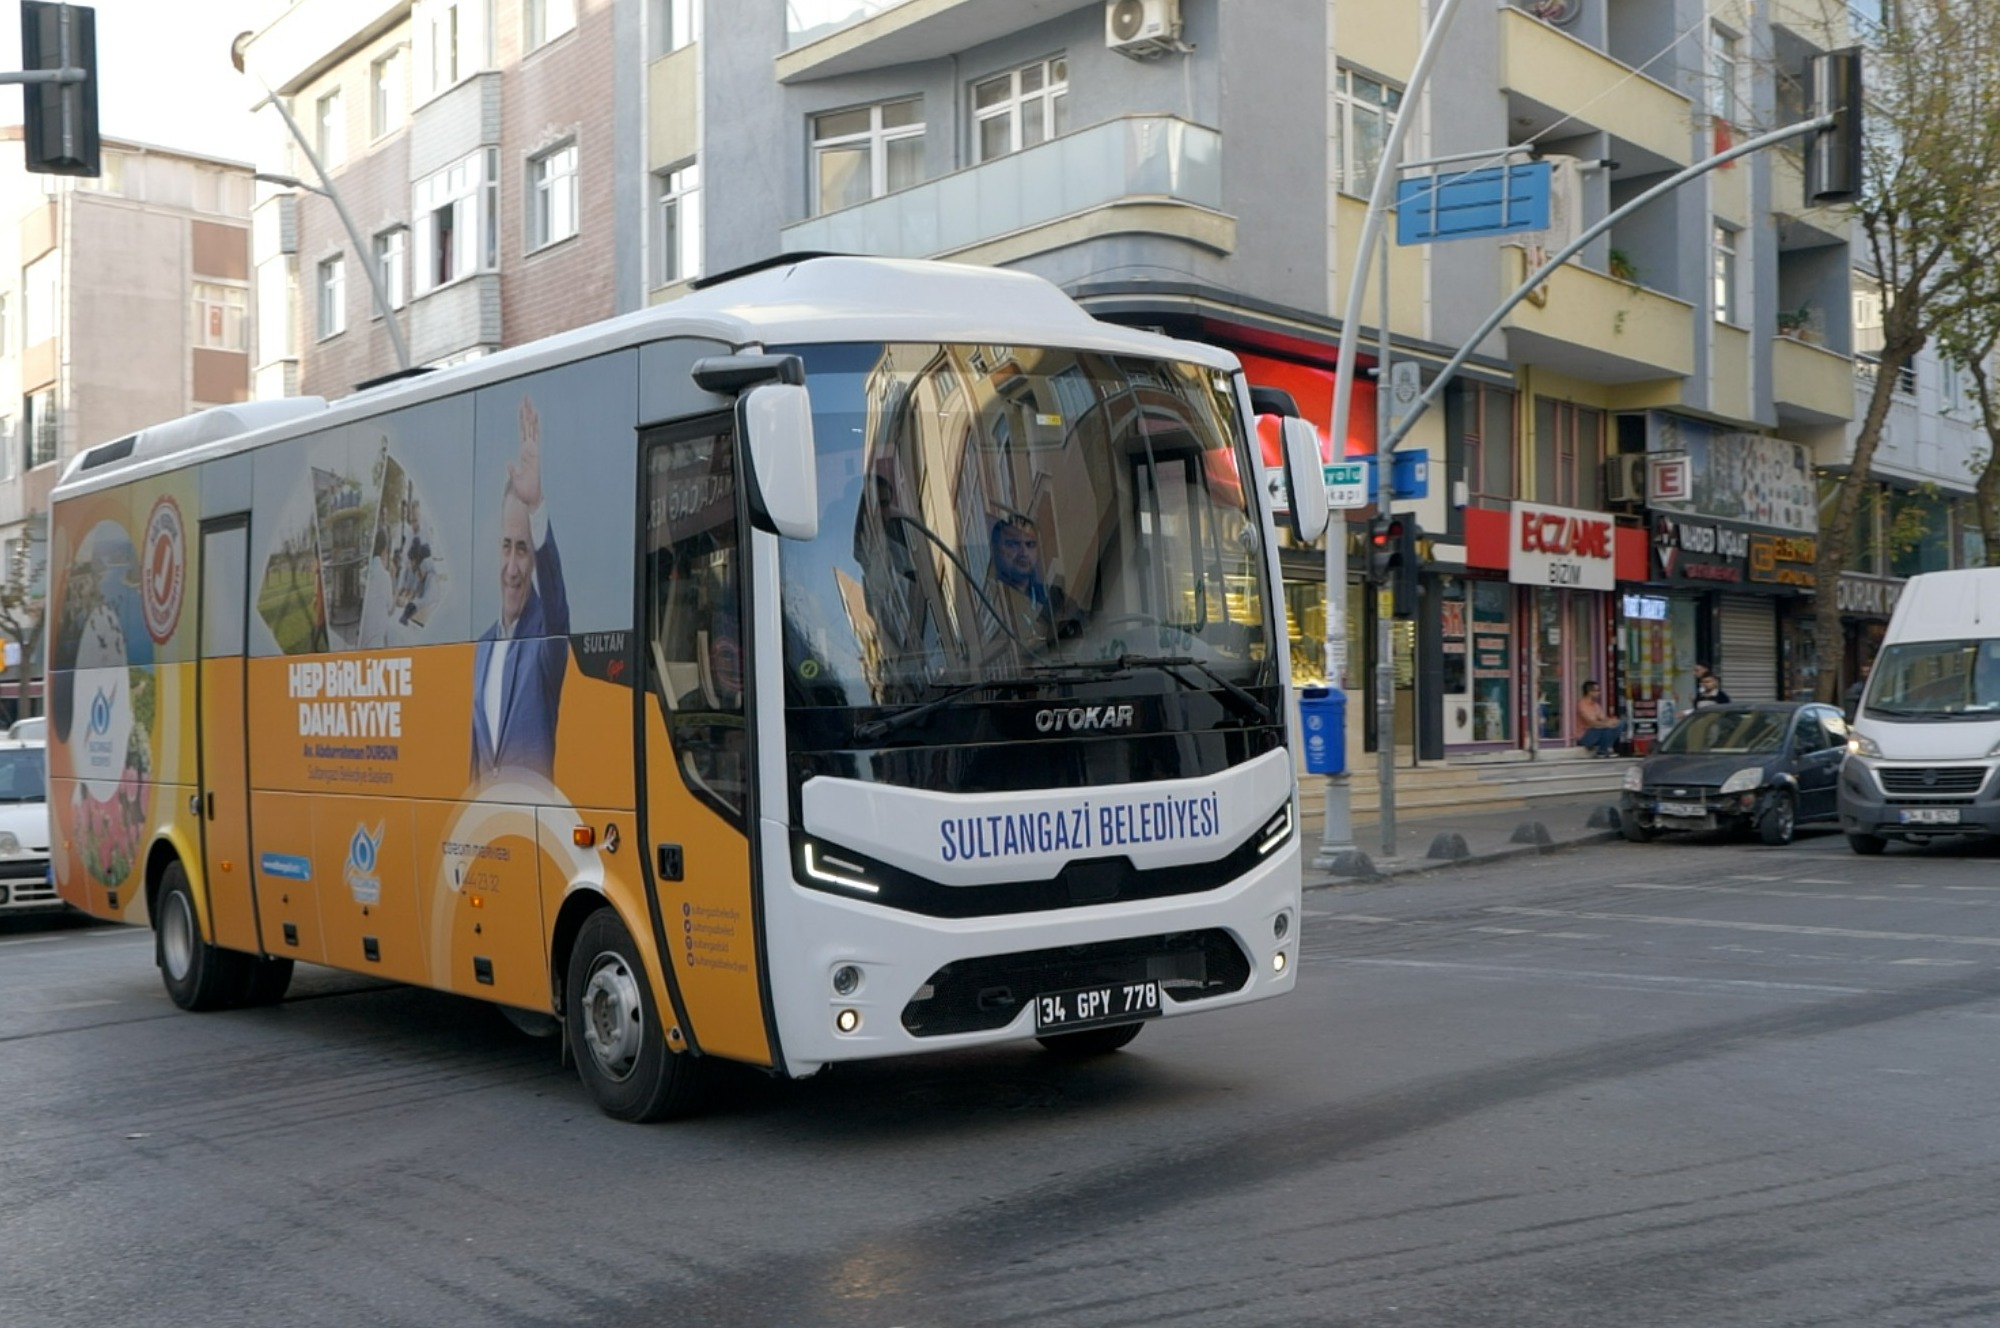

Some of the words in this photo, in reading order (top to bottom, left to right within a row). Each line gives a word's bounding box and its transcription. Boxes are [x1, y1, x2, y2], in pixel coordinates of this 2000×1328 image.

[1659, 467, 1678, 493] E
[1522, 512, 1611, 559] ECZANE
[583, 633, 624, 654] SULTAN
[289, 662, 323, 698] HEP
[325, 658, 412, 697] BİRLİKTE
[299, 702, 350, 737] DAHA
[351, 701, 401, 737] İYİYE
[1036, 705, 1134, 732] OTOKAR
[941, 802, 1091, 861] SULTANGAZİ
[1099, 791, 1219, 845] BELEDİYESİ
[1042, 996, 1066, 1023] 34
[1077, 989, 1111, 1018] GPY
[1123, 983, 1157, 1011] 778
